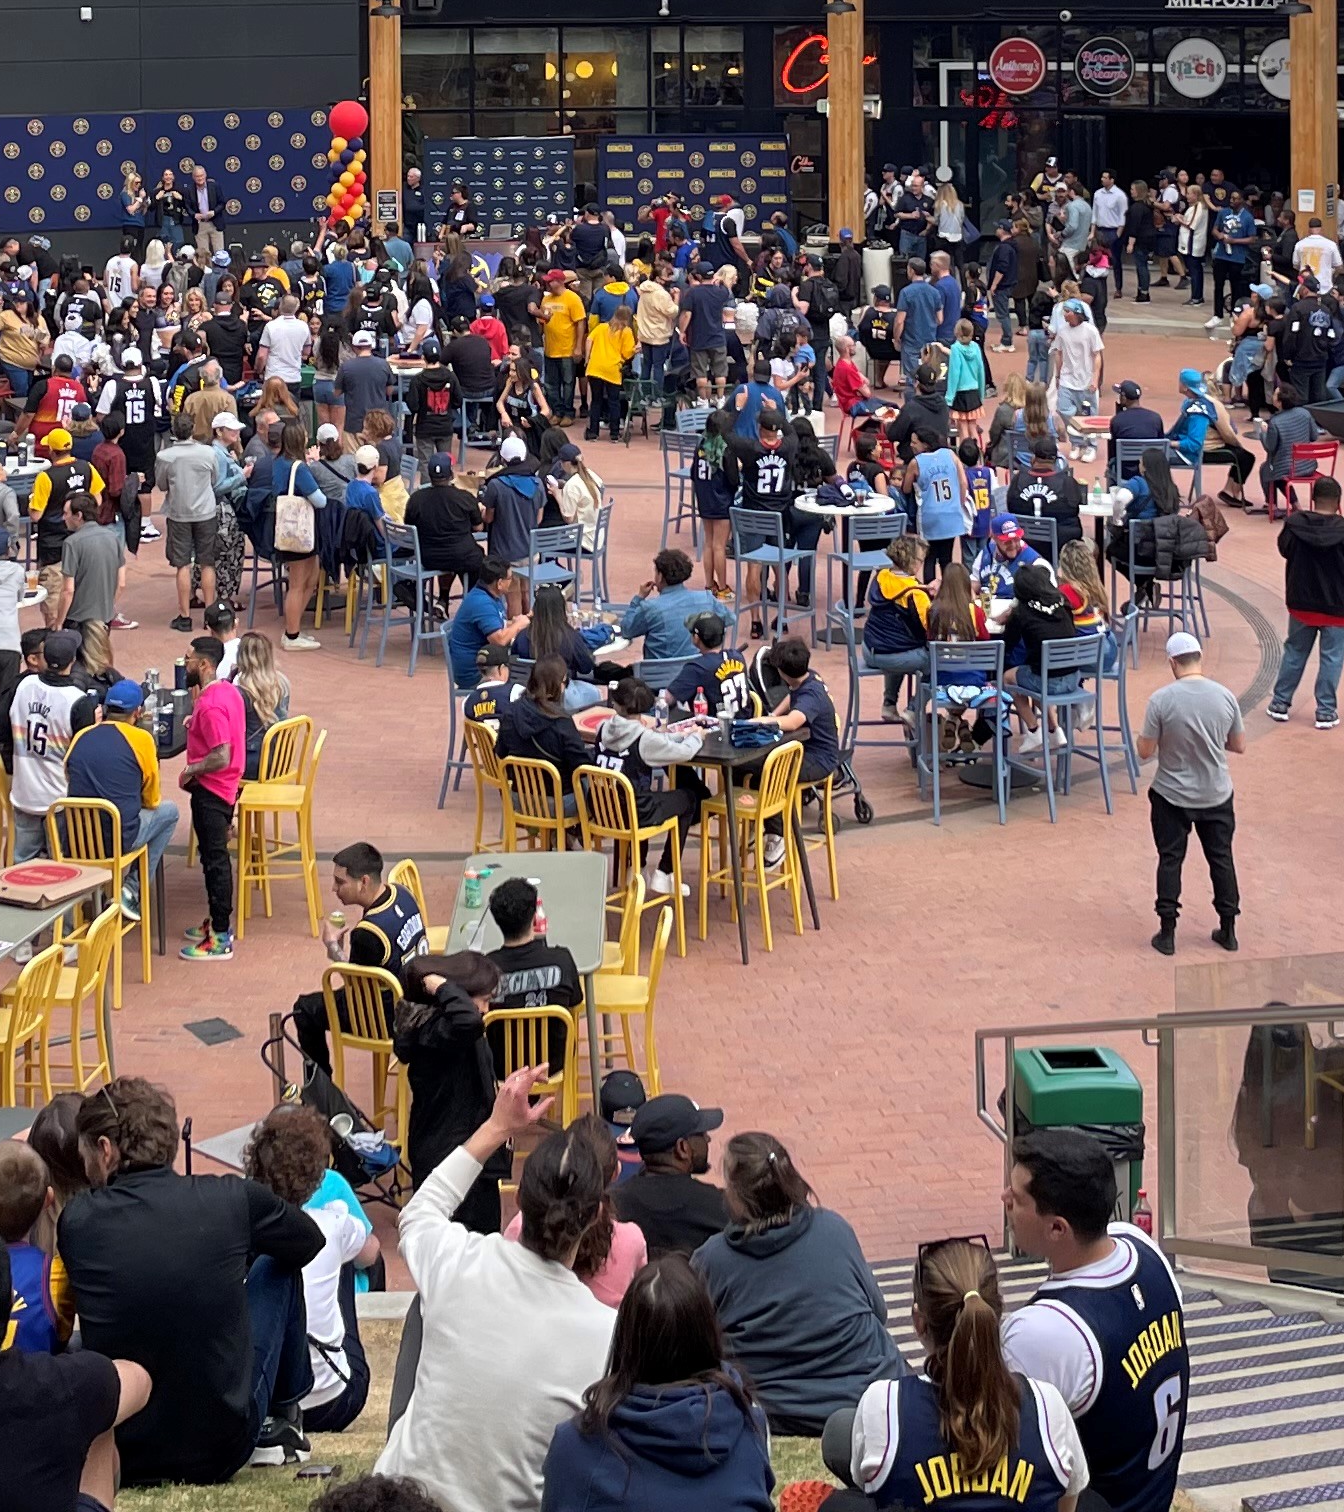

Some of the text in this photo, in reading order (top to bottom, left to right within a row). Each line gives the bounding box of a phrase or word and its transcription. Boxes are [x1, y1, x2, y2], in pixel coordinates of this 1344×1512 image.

[996, 56, 1040, 75] Anthony's
[1081, 51, 1128, 64] Burgers
[1081, 67, 1128, 79] Dreams
[110, 276, 122, 292] 15
[126, 400, 145, 424] 15
[757, 467, 785, 494] 27
[932, 479, 951, 503] 15
[974, 488, 990, 510] 15
[1020, 483, 1048, 502] PORTER
[1032, 497, 1041, 518] 1
[715, 658, 744, 681] MURRAY
[720, 672, 748, 715] 27
[26, 719, 48, 756] 15
[396, 913, 423, 951] GORDON
[525, 990, 548, 1007] 24
[1120, 1309, 1183, 1392] JORDAN
[1147, 1370, 1183, 1471] 6
